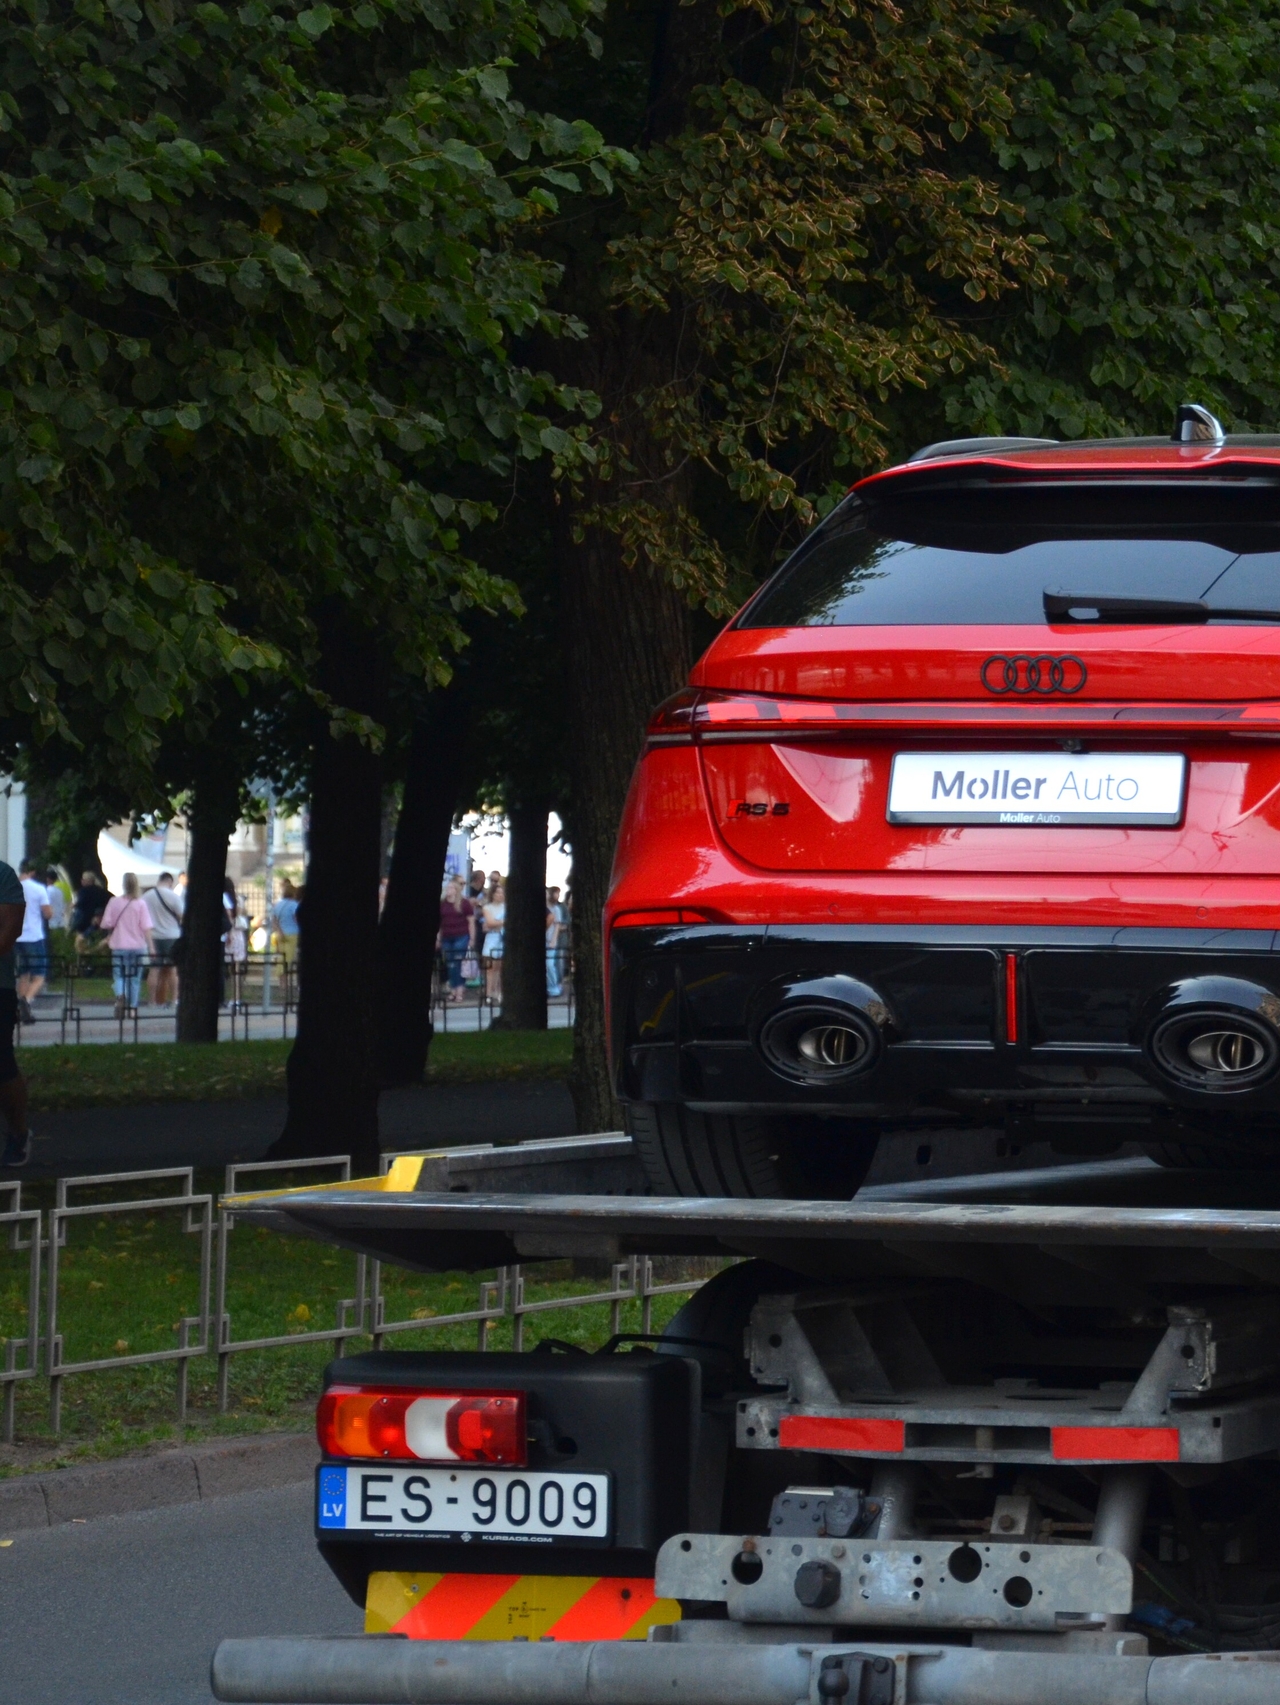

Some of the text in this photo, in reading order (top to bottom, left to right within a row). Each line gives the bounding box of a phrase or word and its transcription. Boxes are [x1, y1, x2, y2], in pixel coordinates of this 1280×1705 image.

[1057, 771, 1139, 800] Auto
[1036, 813, 1061, 823] Auto
[360, 1474, 597, 1529] ES-9009
[323, 1503, 343, 1517] LV
[482, 1535, 553, 1543] KURBADS.COM
